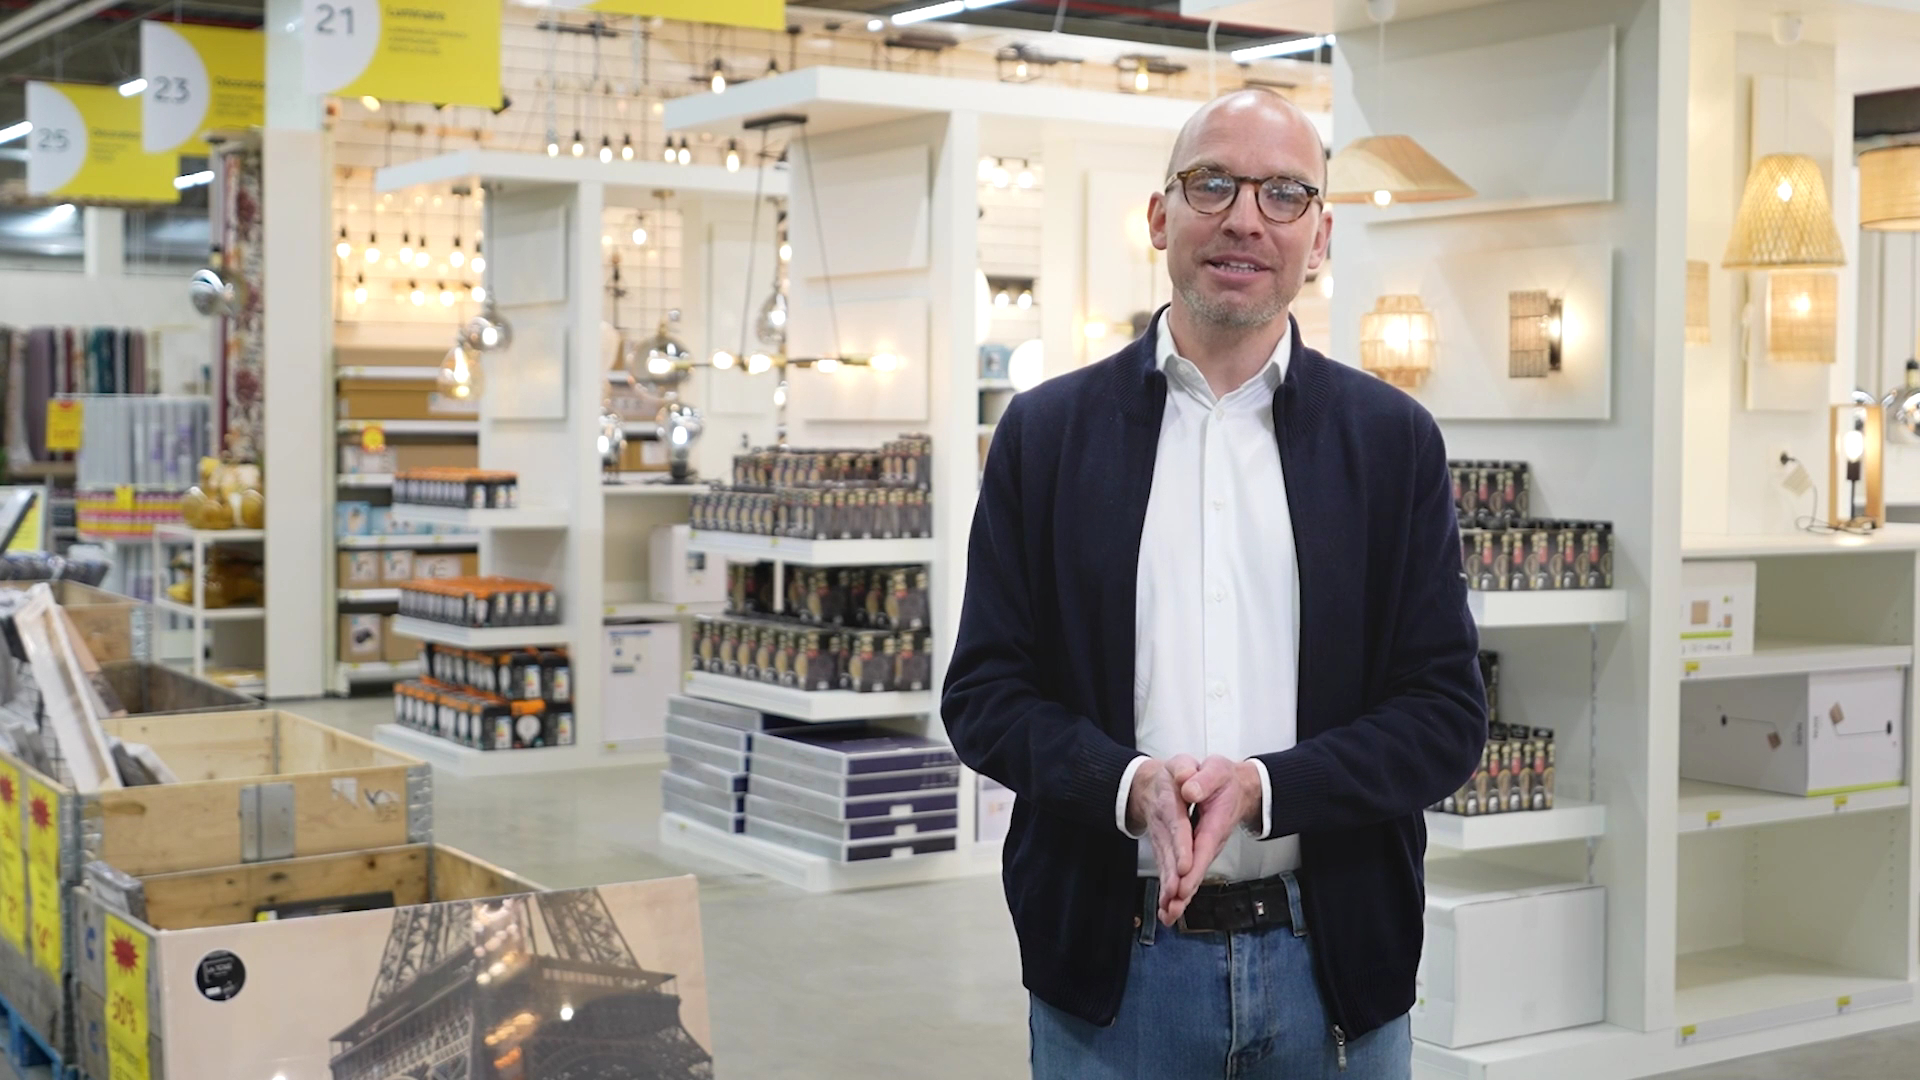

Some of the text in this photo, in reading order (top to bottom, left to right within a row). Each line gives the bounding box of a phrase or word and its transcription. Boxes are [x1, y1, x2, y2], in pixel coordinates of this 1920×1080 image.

[315, 3, 355, 36] 21
[153, 75, 191, 104] 23
[37, 126, 70, 153] 25
